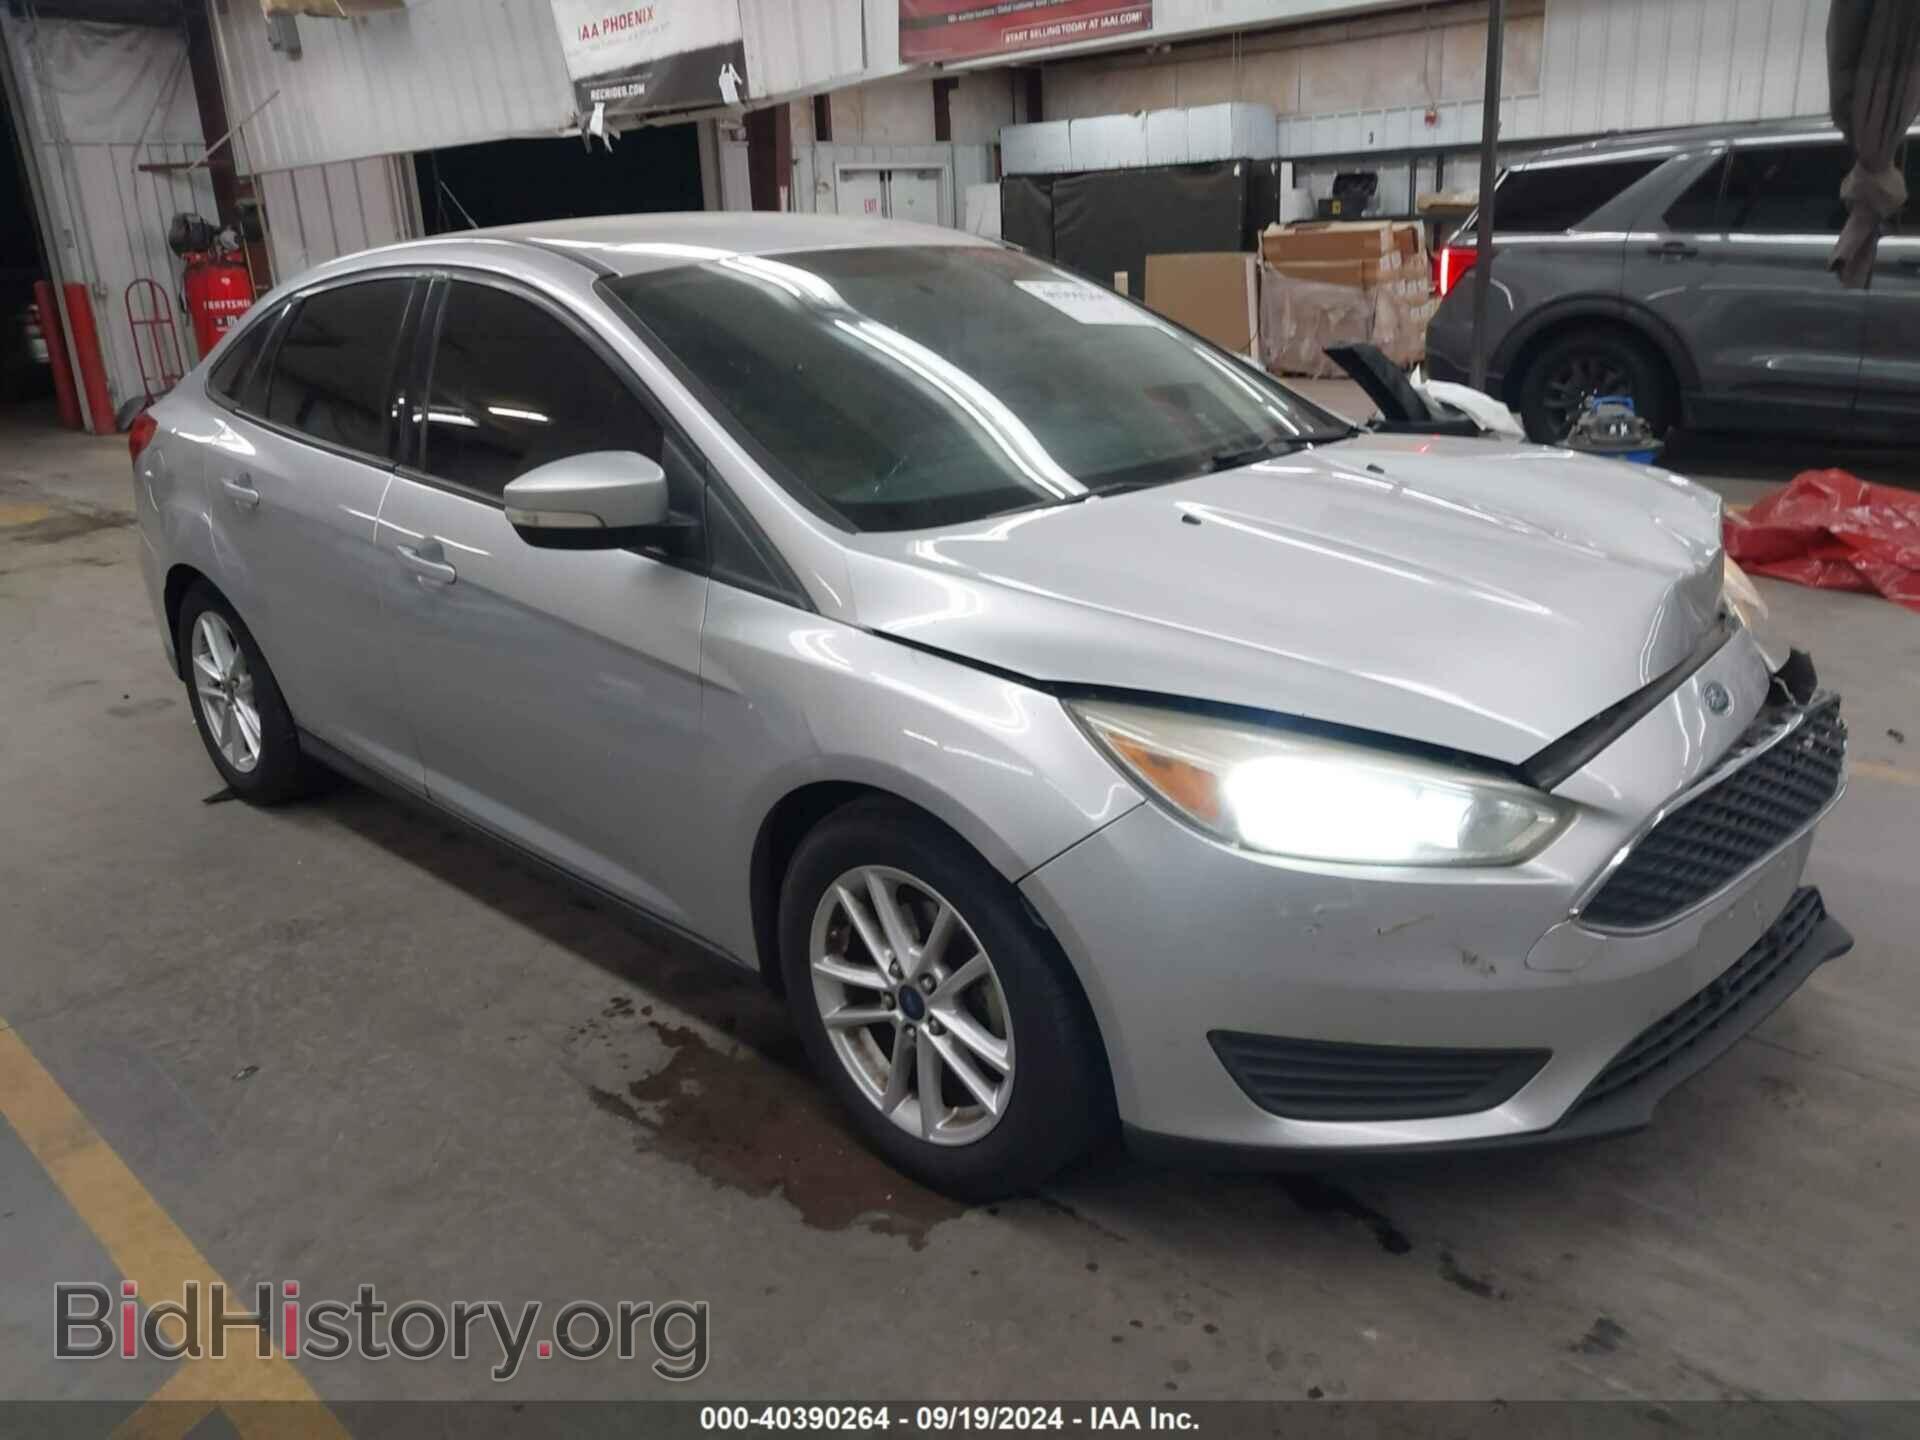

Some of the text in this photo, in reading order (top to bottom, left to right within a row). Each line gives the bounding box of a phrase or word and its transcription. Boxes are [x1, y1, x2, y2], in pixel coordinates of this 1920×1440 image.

[577, 23, 600, 41] IAA
[603, 6, 656, 35] PHOENIX
[1005, 31, 1028, 43] START
[1030, 26, 1060, 39] SELLING
[1061, 22, 1087, 34] TODAY
[1088, 19, 1099, 29] AT
